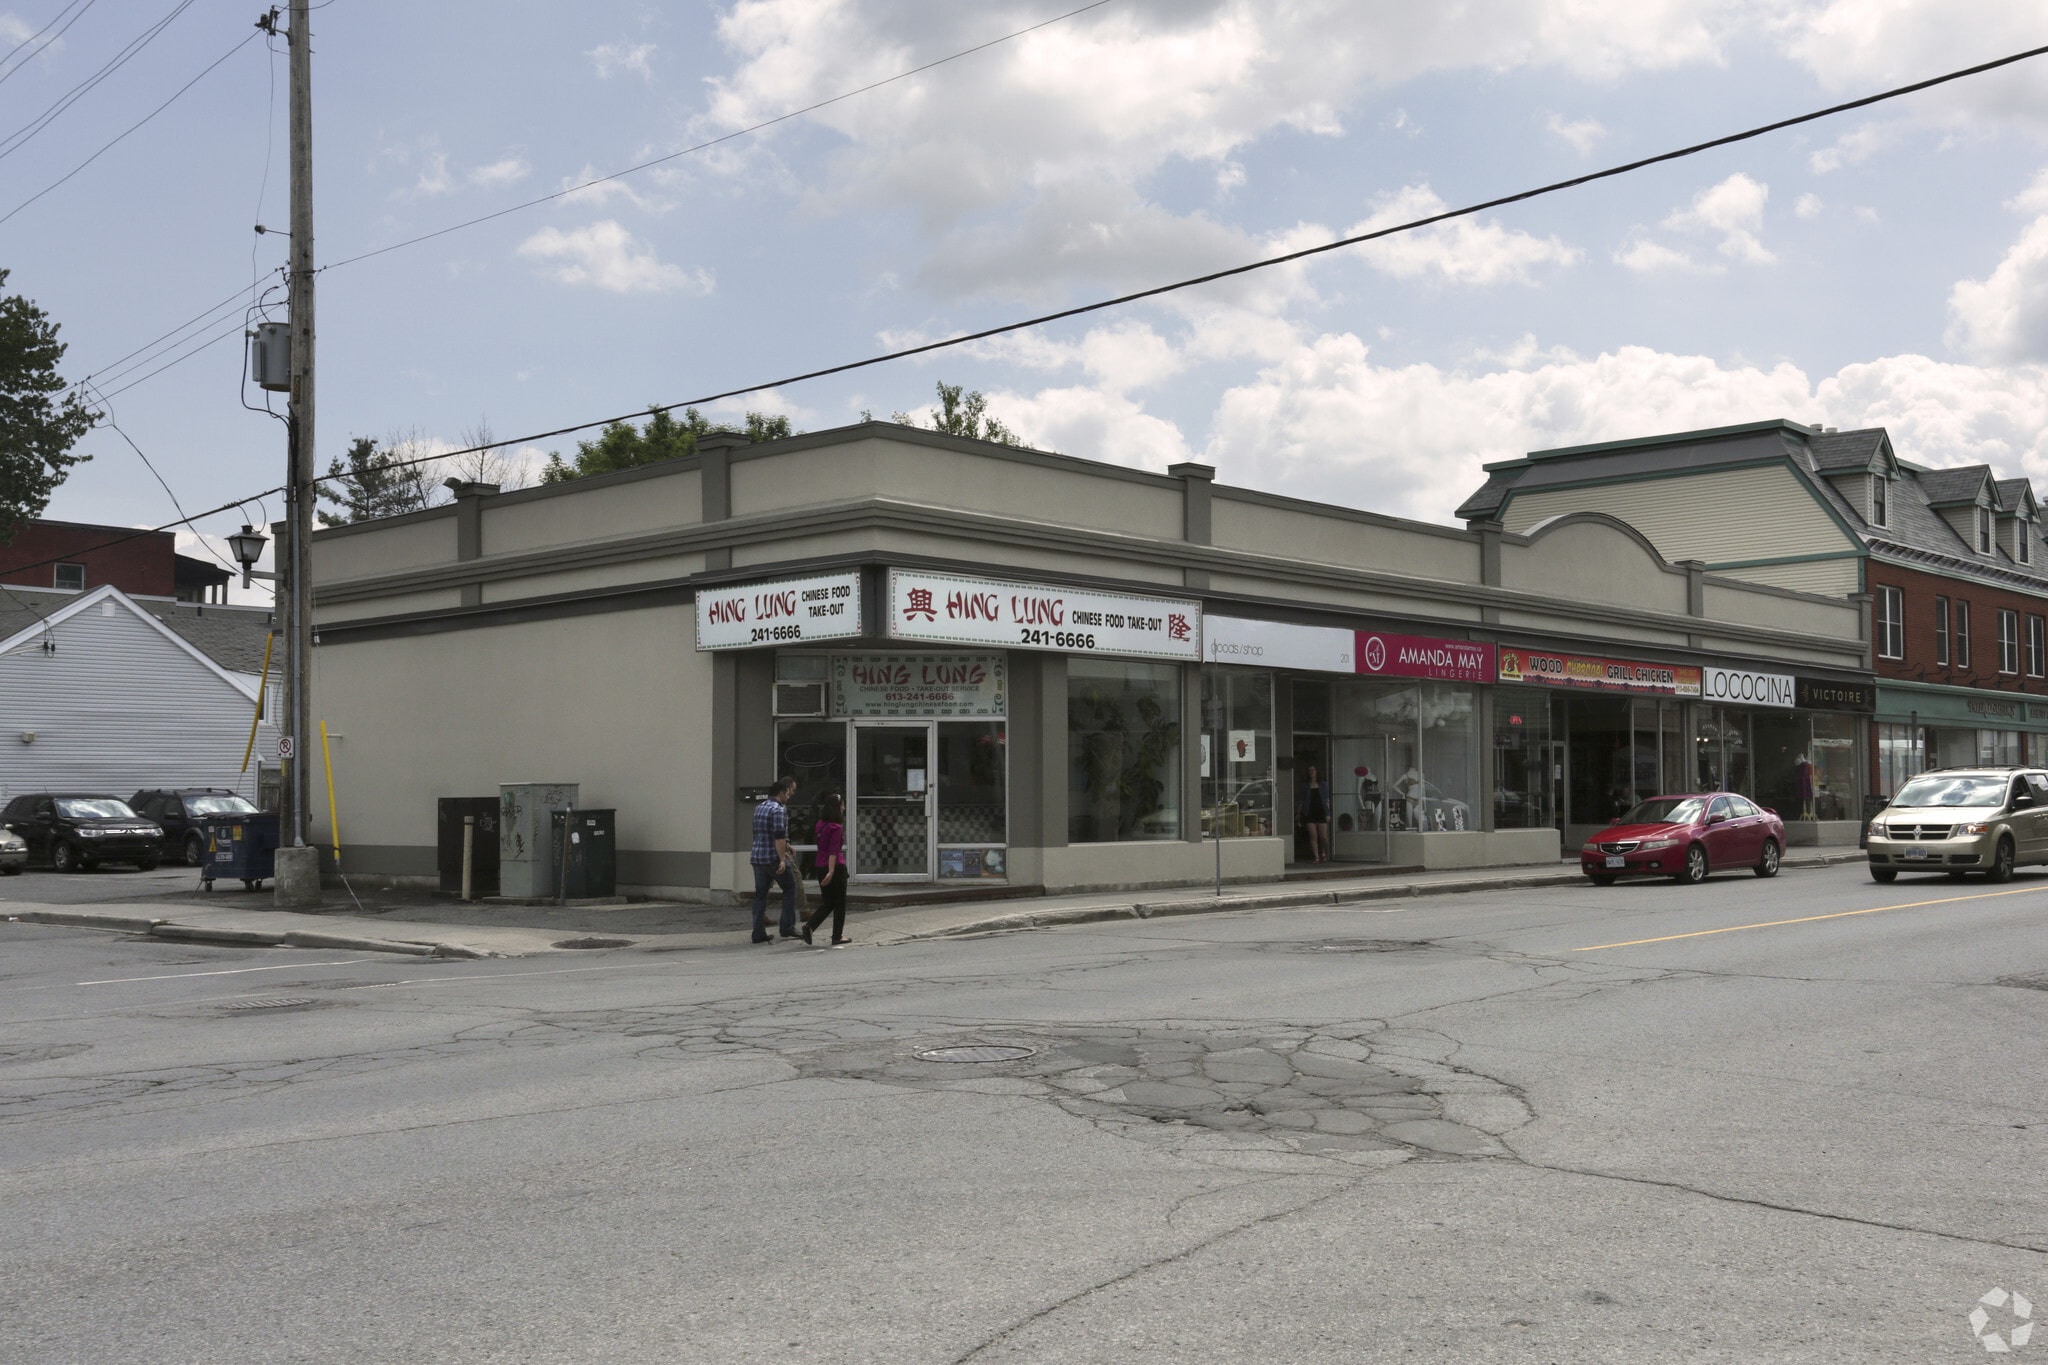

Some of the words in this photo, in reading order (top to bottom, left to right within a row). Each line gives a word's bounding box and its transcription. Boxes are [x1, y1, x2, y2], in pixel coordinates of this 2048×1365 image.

[801, 587, 829, 602] CHINESE
[831, 585, 851, 599] FOOD
[708, 598, 746, 625] HING
[754, 590, 797, 621] LUNG
[808, 603, 845, 618] TAKE-OUT
[902, 587, 938, 622] 興
[946, 589, 999, 622] HING
[1011, 594, 1064, 627] LUNG
[1072, 610, 1102, 626] CHINESE
[1105, 613, 1125, 629] FOOD
[1127, 616, 1162, 631] TAKE-OUT
[1168, 613, 1192, 642] 隆
[751, 624, 801, 642] 241-6666
[1021, 628, 1095, 649] 241-6666
[1399, 647, 1454, 668] AMANDA
[1457, 651, 1484, 670] MAY
[852, 663, 911, 685] HING
[921, 663, 987, 685] LUNG
[1428, 668, 1482, 680] LINGERIE
[1529, 655, 1563, 674] WOOD
[1606, 664, 1633, 681] GRILL
[1635, 667, 1674, 684] CHICKEN
[885, 692, 954, 701] 613-241-6666
[1704, 670, 1794, 705] LOCOCINA
[1813, 688, 1862, 703] VICTOIRE
